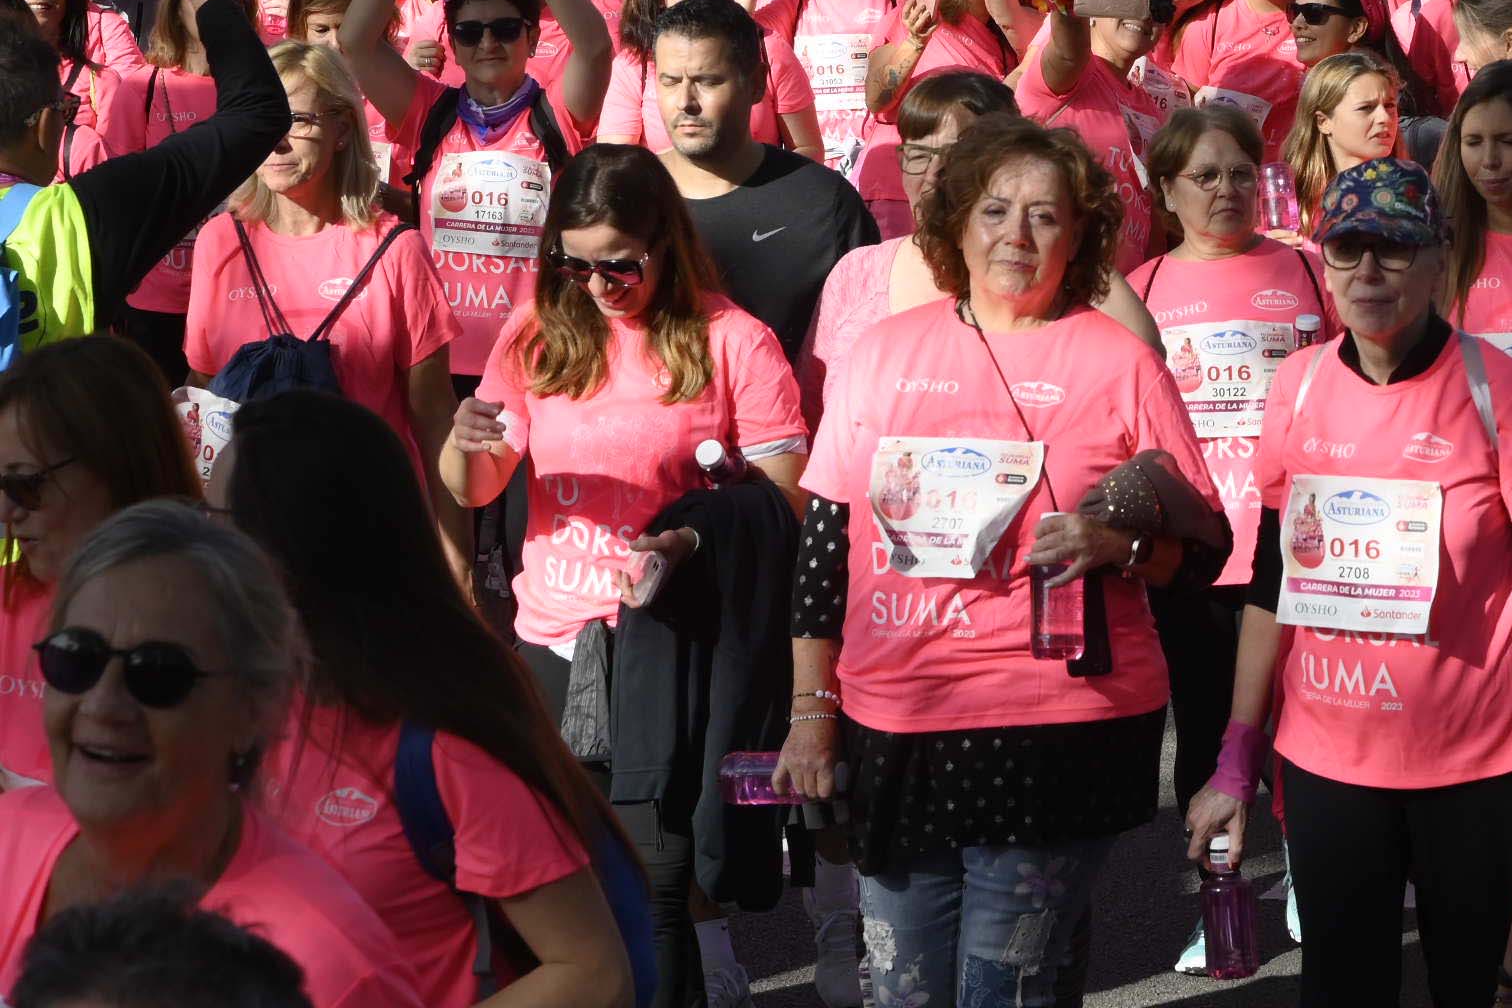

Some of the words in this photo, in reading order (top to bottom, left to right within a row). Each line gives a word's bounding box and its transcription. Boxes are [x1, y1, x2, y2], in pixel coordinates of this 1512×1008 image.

[816, 64, 845, 75] 016
[471, 190, 509, 207] 016
[474, 210, 504, 220] 17163
[446, 221, 476, 230] CARRERA
[494, 224, 517, 233] MUJER
[442, 232, 475, 246] OYSHO
[500, 239, 537, 249] Santander
[1254, 294, 1298, 306] ASTURIANA
[1155, 300, 1208, 323] OYSHO
[1204, 339, 1253, 350] ASTURIANA
[1207, 365, 1252, 383] 016
[895, 378, 960, 393] OYSHO
[1212, 386, 1247, 398] 30122
[1215, 402, 1227, 410] DE
[1228, 401, 1237, 410] LA
[1238, 401, 1265, 410] MUJER
[1303, 436, 1357, 459] OYSHO
[926, 454, 986, 471] ASTURIANA
[997, 454, 1031, 466] SUMA
[543, 474, 580, 506] TU
[926, 489, 978, 509] 016
[1326, 501, 1385, 518] ASTURIANA
[931, 516, 964, 529] 2707
[928, 534, 941, 545] DE
[1329, 537, 1382, 560] 016
[544, 556, 622, 597] SUM
[1338, 566, 1371, 580] 2708
[1300, 581, 1338, 594] CARRERA
[1339, 585, 1350, 595] DE
[1351, 586, 1362, 596] LA
[1362, 586, 1396, 597] MUJER
[1398, 589, 1421, 598] 2023
[871, 590, 972, 627] SUMA
[1294, 600, 1338, 617] OYSHO
[1372, 607, 1422, 620] Santander
[953, 628, 976, 639] 2023
[1380, 702, 1404, 712] 2023
